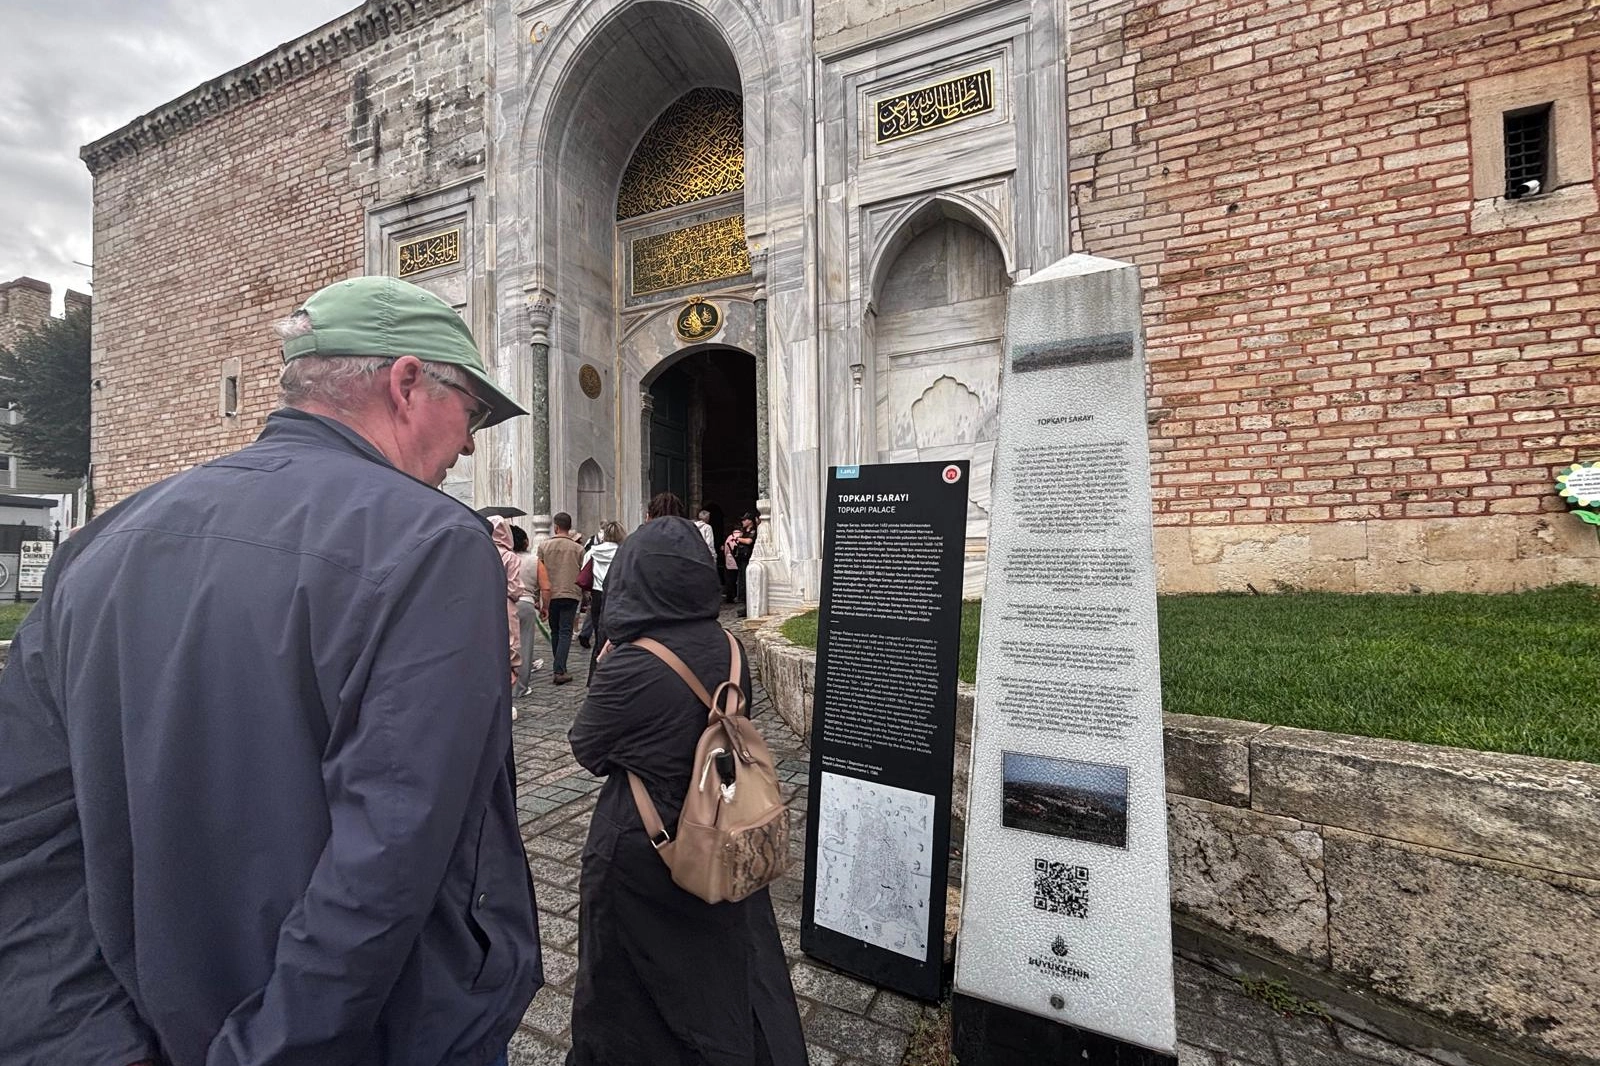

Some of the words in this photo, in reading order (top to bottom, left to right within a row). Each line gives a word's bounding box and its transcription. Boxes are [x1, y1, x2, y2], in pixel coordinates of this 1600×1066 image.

[838, 494, 874, 503] TOPKAPI
[877, 493, 909, 502] SARAYI
[838, 506, 867, 514] TOPKAPI
[868, 505, 896, 514] PALACE
